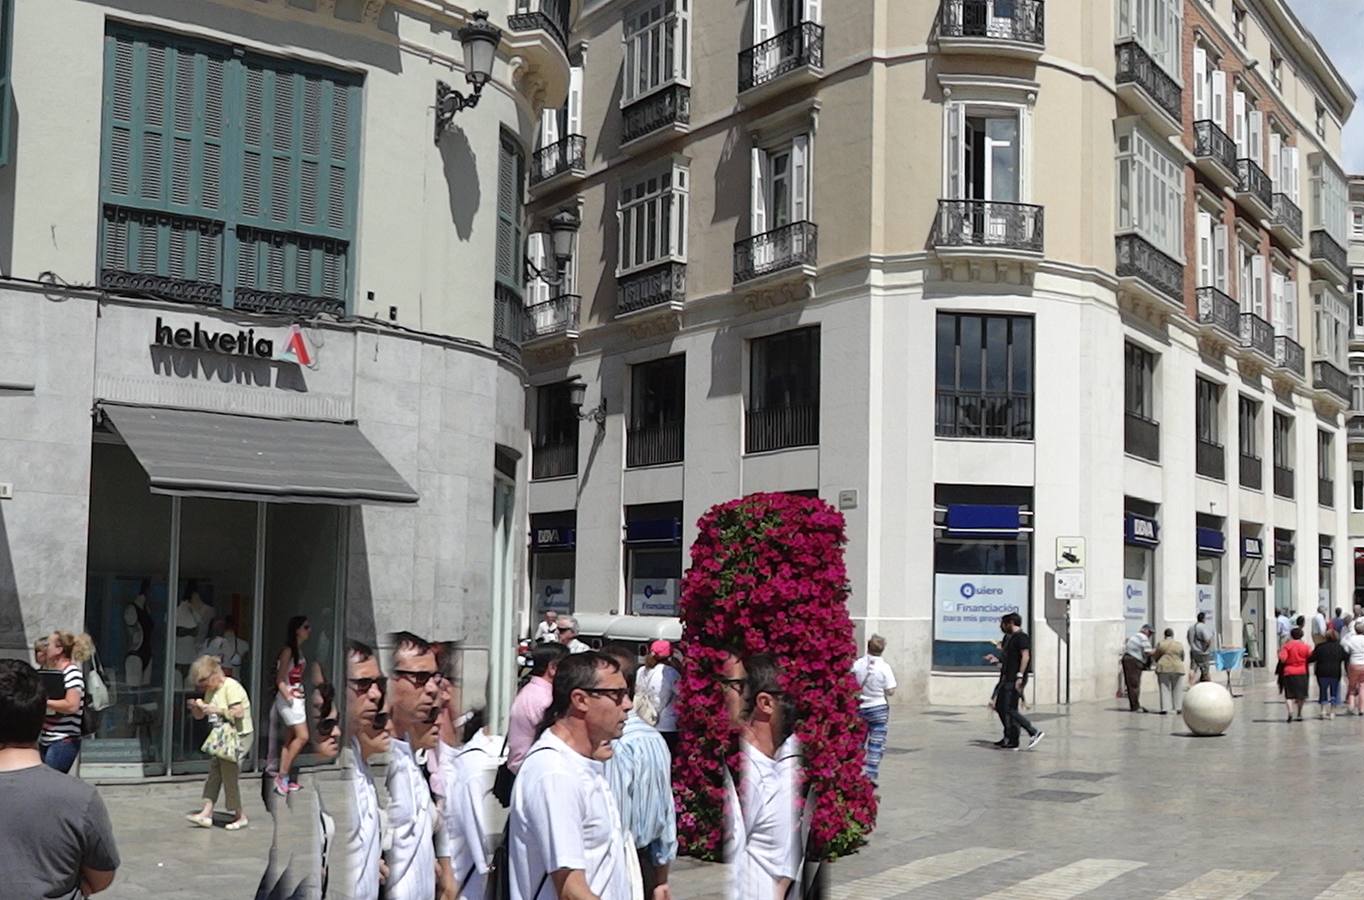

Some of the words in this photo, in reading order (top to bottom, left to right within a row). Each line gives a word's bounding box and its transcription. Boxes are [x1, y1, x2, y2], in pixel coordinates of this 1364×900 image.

[155, 316, 274, 358] helvetia
[960, 582, 1004, 599] Quiero
[956, 602, 1019, 613] Financiación
[943, 615, 962, 623] para
[963, 614, 978, 622] mis
